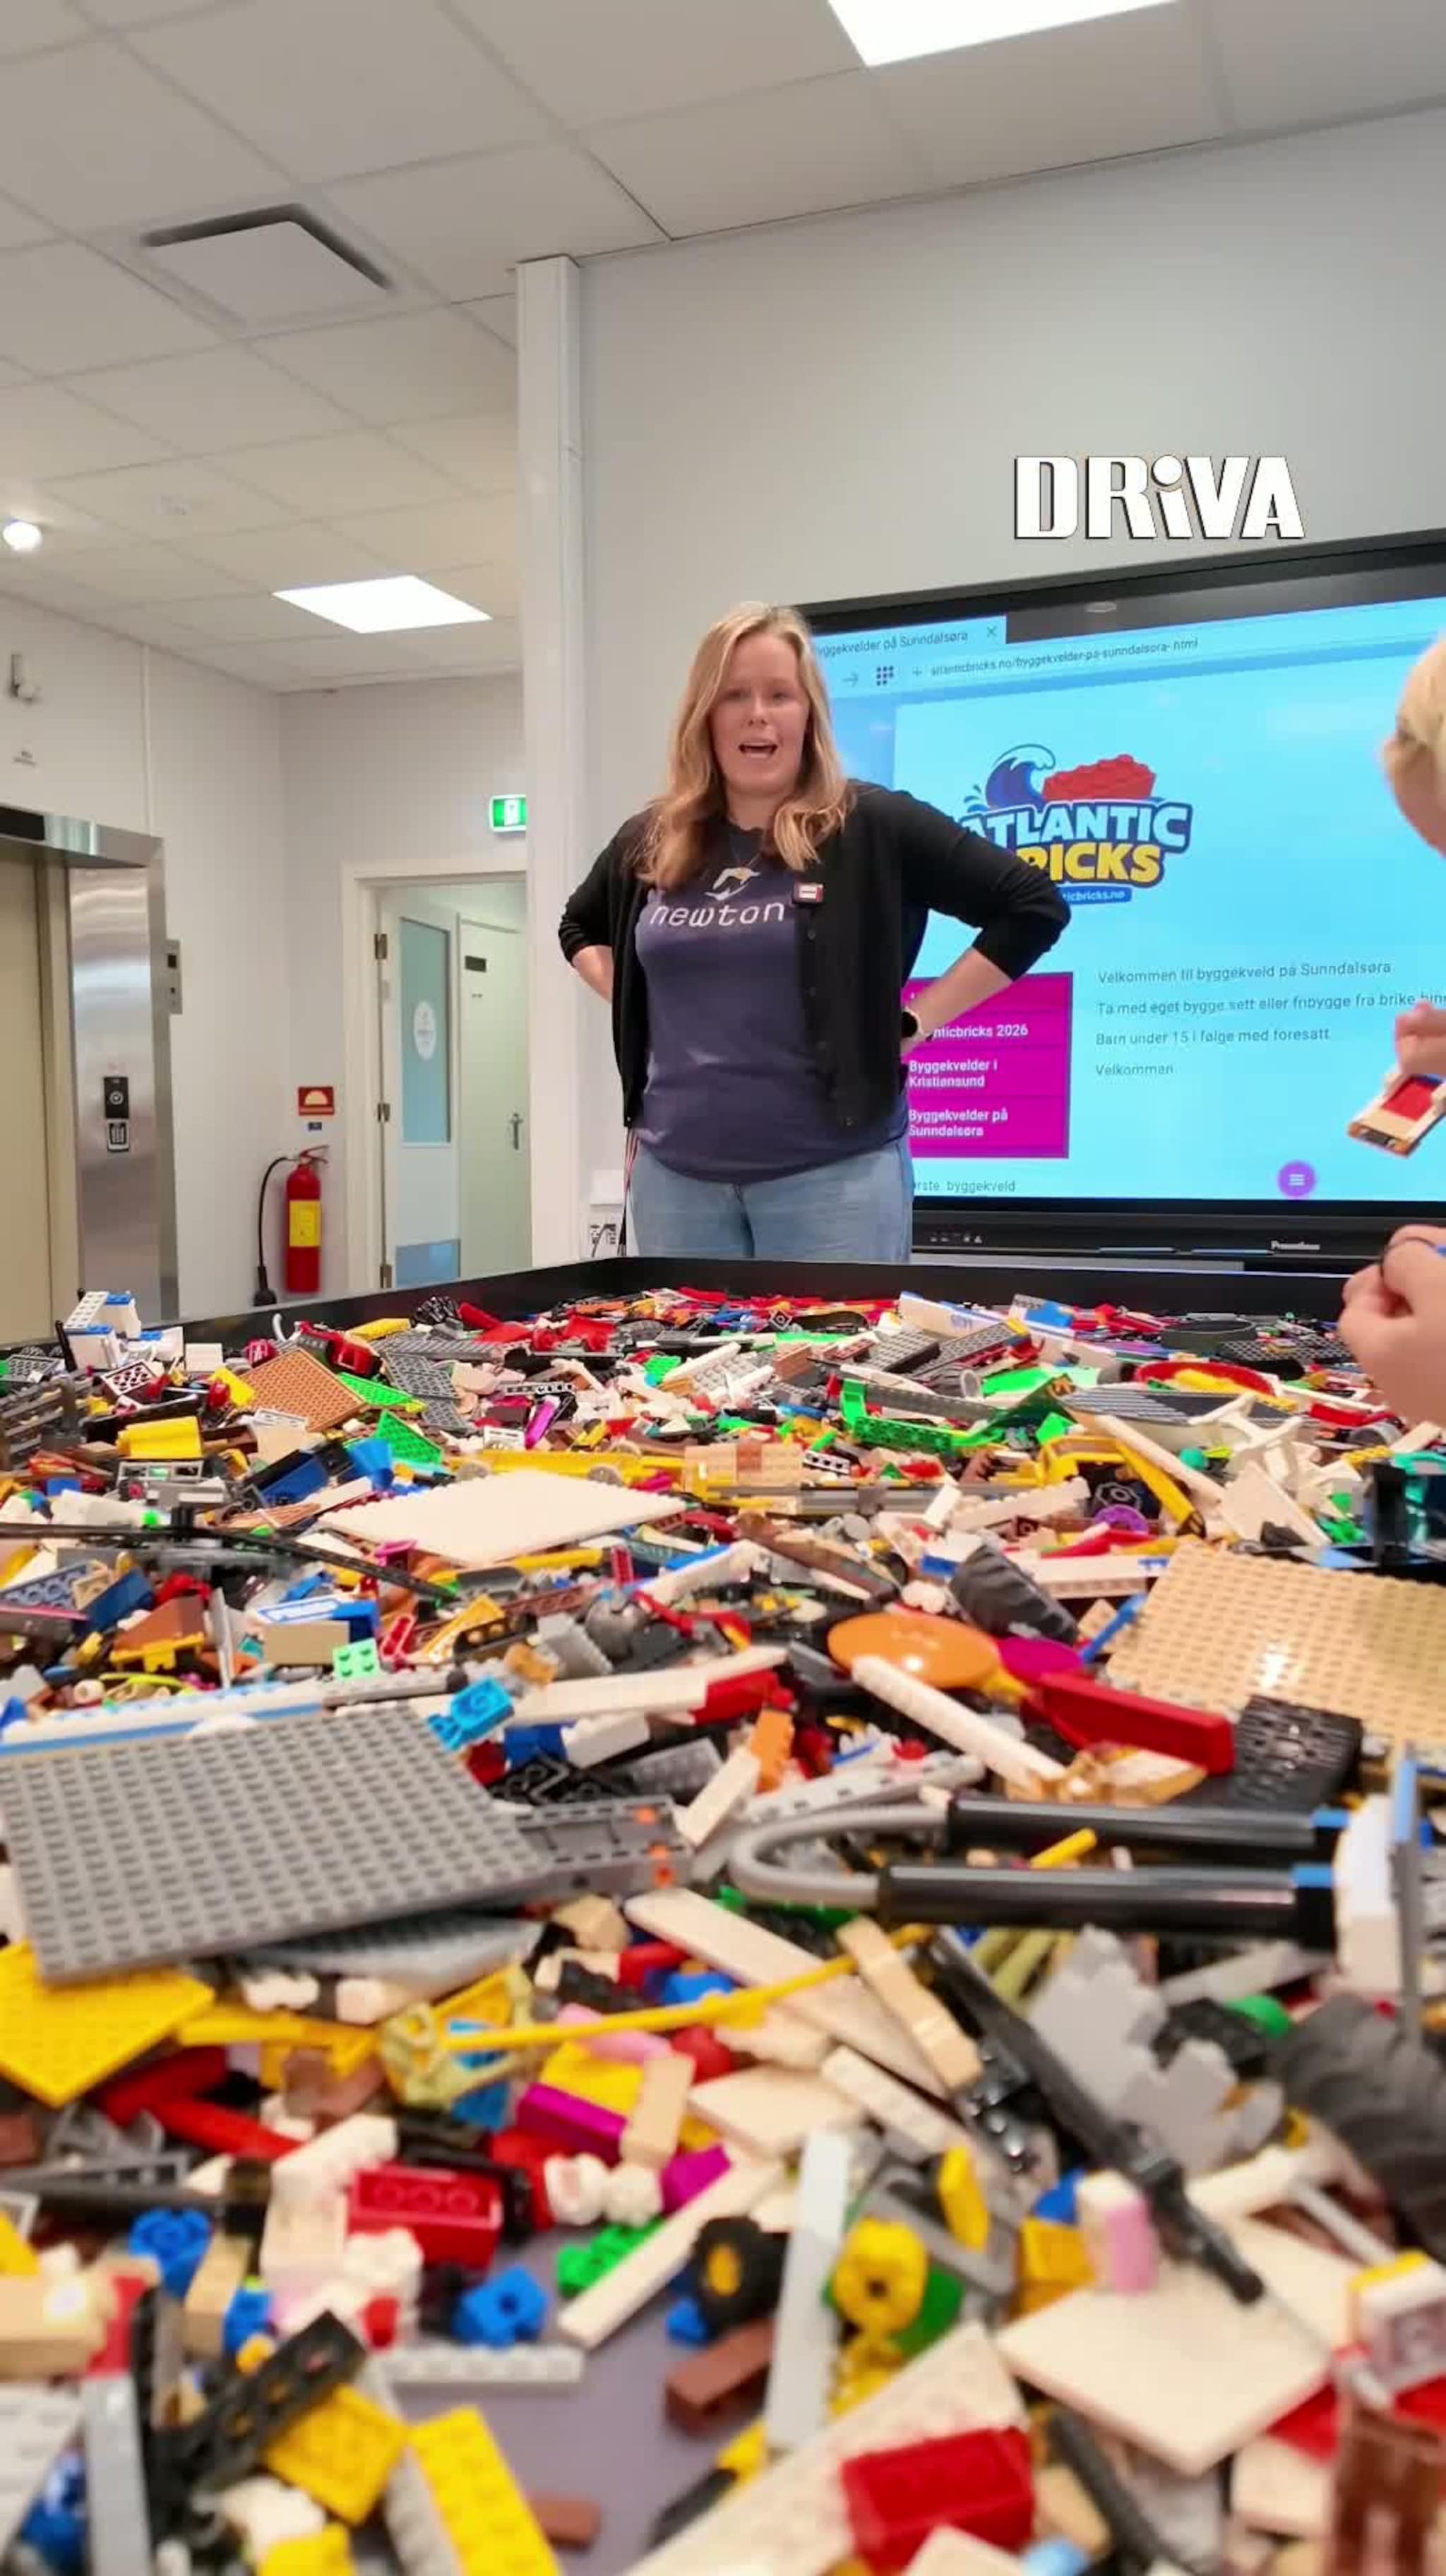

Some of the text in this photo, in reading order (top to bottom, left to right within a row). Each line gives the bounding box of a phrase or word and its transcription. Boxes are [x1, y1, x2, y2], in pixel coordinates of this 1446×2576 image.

[817, 640, 881, 657] yggekvelder
[1016, 842, 1161, 883] RICKS
[650, 902, 785, 927] newton
[1098, 970, 1176, 984] Velkommen
[1181, 968, 1193, 981] til
[1197, 965, 1274, 982] byggekveld
[1098, 1002, 1114, 1015] Ta
[1118, 1002, 1147, 1014] med
[1150, 1001, 1180, 1015] eget
[1183, 1000, 1224, 1015] bygge
[1229, 998, 1255, 1010] sett
[1259, 998, 1289, 1010] eller
[1293, 995, 1351, 1010] fribygge
[1356, 994, 1375, 1007] fra
[1380, 992, 1416, 1006] brike
[933, 1024, 1029, 1039] nticbricks 2026
[1096, 1033, 1126, 1045] Barn
[1130, 1032, 1167, 1044] under
[1173, 1031, 1189, 1043] 15
[1238, 1030, 1269, 1042] med
[1273, 1028, 1330, 1041] foresatt
[909, 1059, 990, 1074] Byggekvelder
[1096, 1063, 1174, 1076] Velkommen
[909, 1075, 986, 1087] Kristiansund
[909, 1107, 1008, 1123] Byggekvelder på
[947, 1180, 1016, 1193] byggekveld
